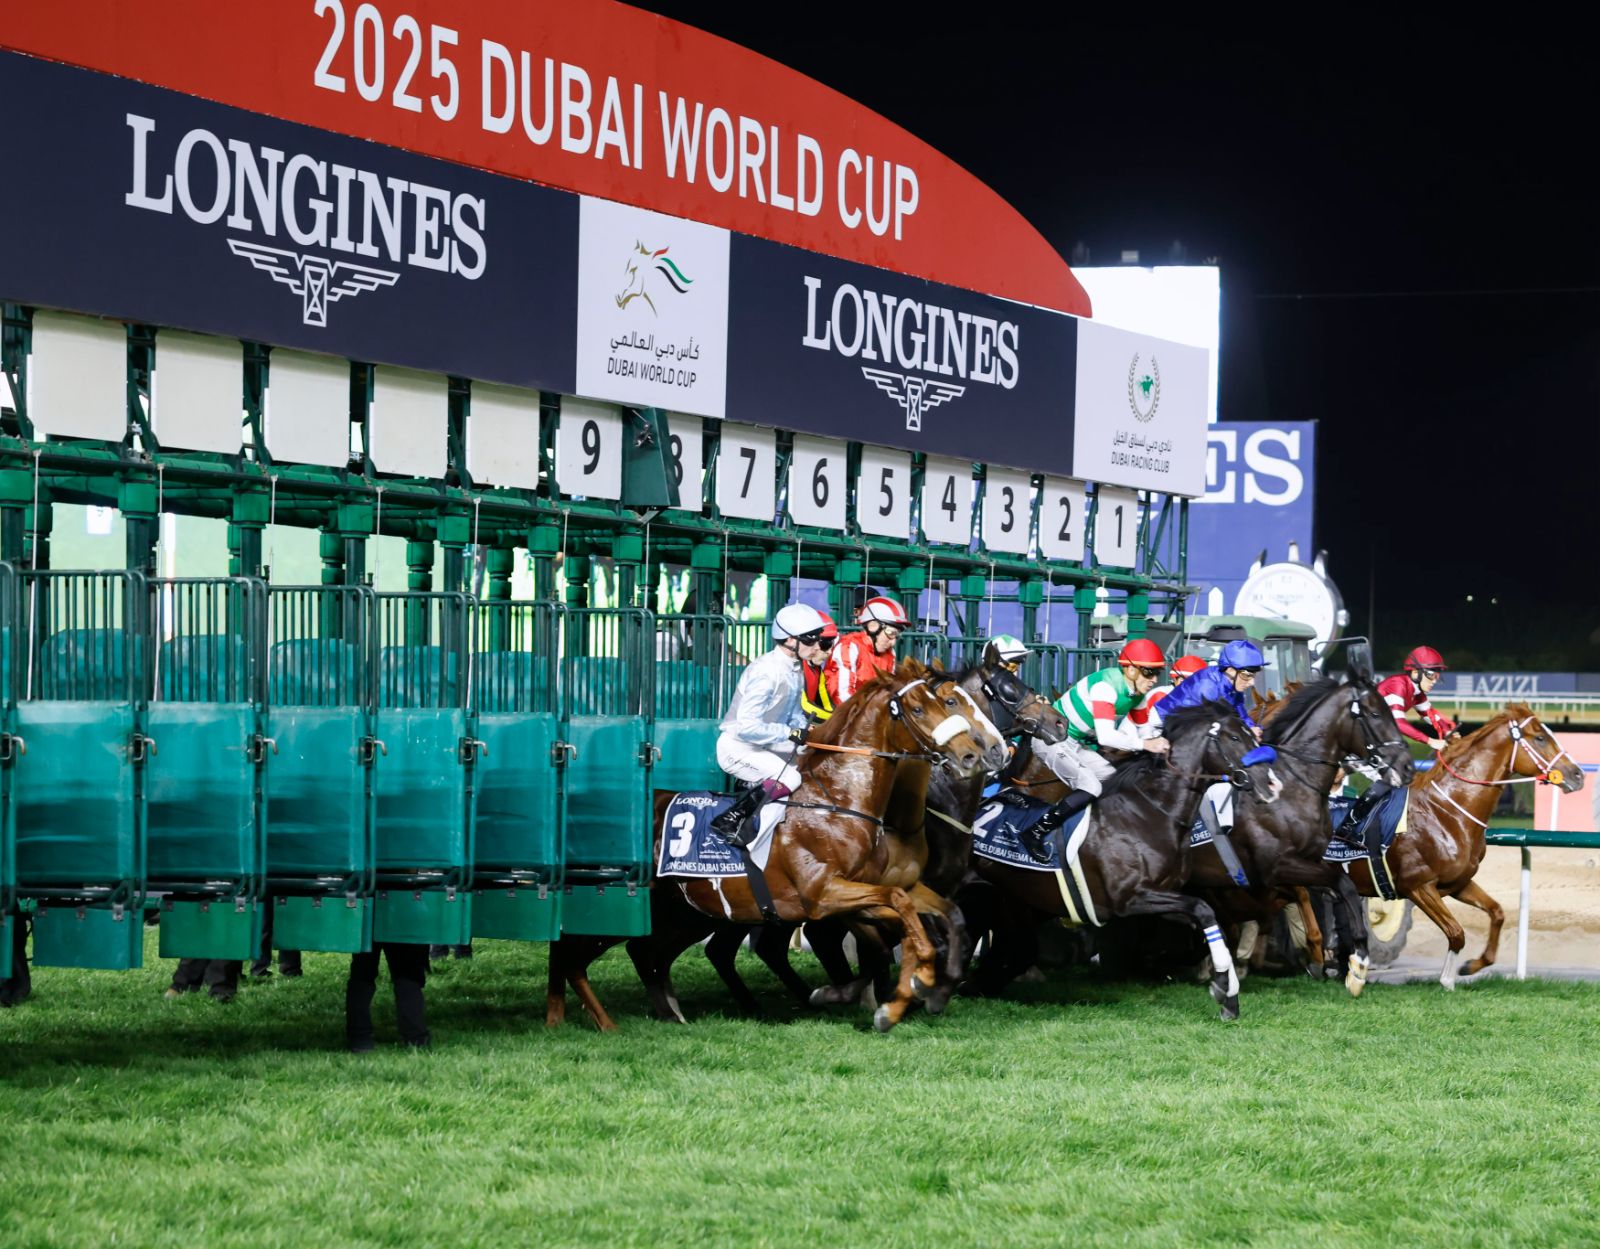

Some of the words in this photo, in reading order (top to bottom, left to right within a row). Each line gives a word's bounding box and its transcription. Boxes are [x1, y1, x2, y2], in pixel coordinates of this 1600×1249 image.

[314, 0, 459, 121] 2025
[482, 38, 643, 169] DUBAI
[658, 90, 823, 217] WORLD
[838, 148, 919, 241] CUP
[125, 112, 487, 280] LONGINES
[610, 331, 654, 353] العالمي
[655, 344, 675, 361] دبي
[677, 336, 699, 361] كأس
[802, 275, 1019, 390] LONGINES
[607, 357, 638, 378] DUBAI
[640, 362, 675, 385] WORLD
[677, 369, 697, 388] CUP
[582, 419, 600, 475] 9
[669, 434, 683, 487] 8
[1111, 451, 1130, 466] DUBAI
[1131, 454, 1153, 470] RACING
[1154, 458, 1169, 473] CLUB
[1146, 440, 1157, 454] دبي
[740, 447, 756, 499] 7
[812, 458, 829, 508] 6
[879, 467, 893, 517] 5
[941, 475, 957, 522] 4
[1001, 486, 1014, 533] 3
[1058, 496, 1071, 541] 2
[1114, 505, 1123, 548] 1
[1474, 674, 1538, 697] AZIZI
[890, 703, 899, 716] 3
[1209, 722, 1221, 736] 2
[669, 811, 695, 858] 3
[973, 801, 1004, 838] 2
[698, 862, 719, 872] DUBAI
[988, 845, 1007, 857] DUBAI
